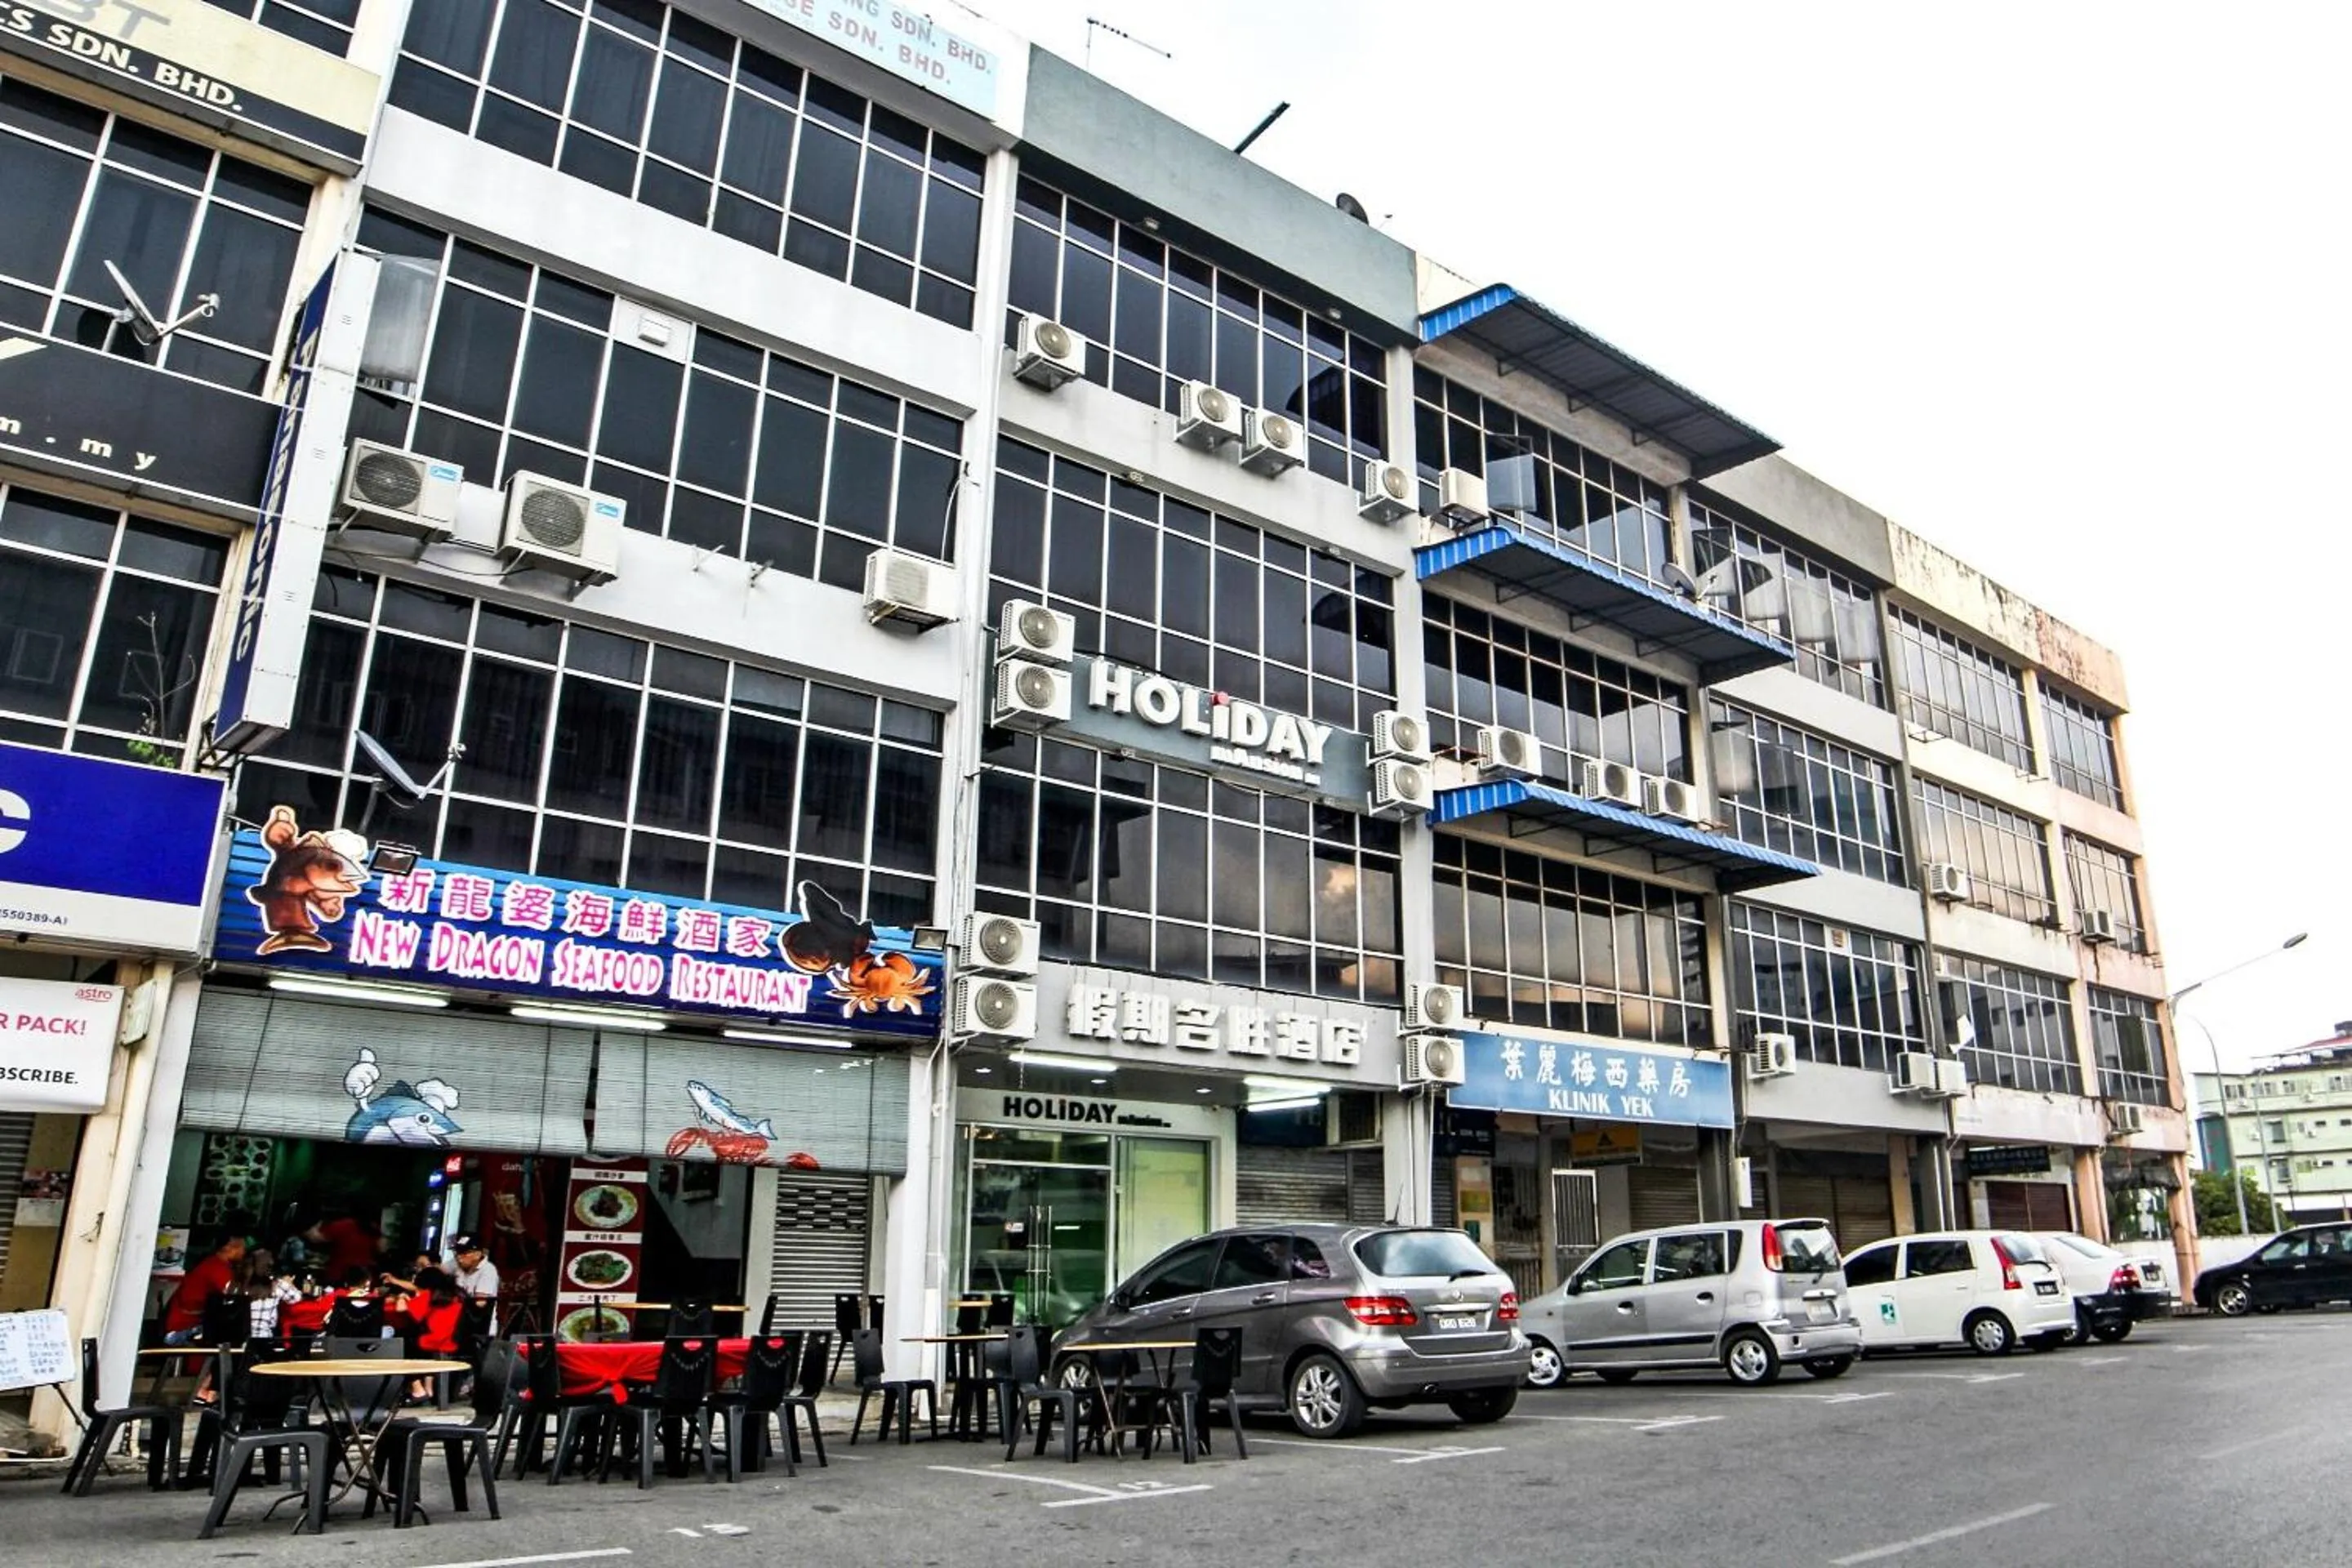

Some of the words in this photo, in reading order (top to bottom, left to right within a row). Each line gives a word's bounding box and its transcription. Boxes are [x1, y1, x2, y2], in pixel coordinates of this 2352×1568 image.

[47, 24, 139, 73] SDN.
[154, 62, 243, 111] BHD.
[827, 12, 884, 51] SDN.
[899, 44, 951, 84] BHD.
[891, 10, 936, 47] SDN.
[947, 38, 991, 74] BHD.
[235, 327, 318, 662] Panasonic
[16, 1014, 87, 1036] PACK!
[74, 987, 113, 1002] astro
[1549, 1089, 1611, 1115] KLINIK
[1620, 1095, 1655, 1117] YEK
